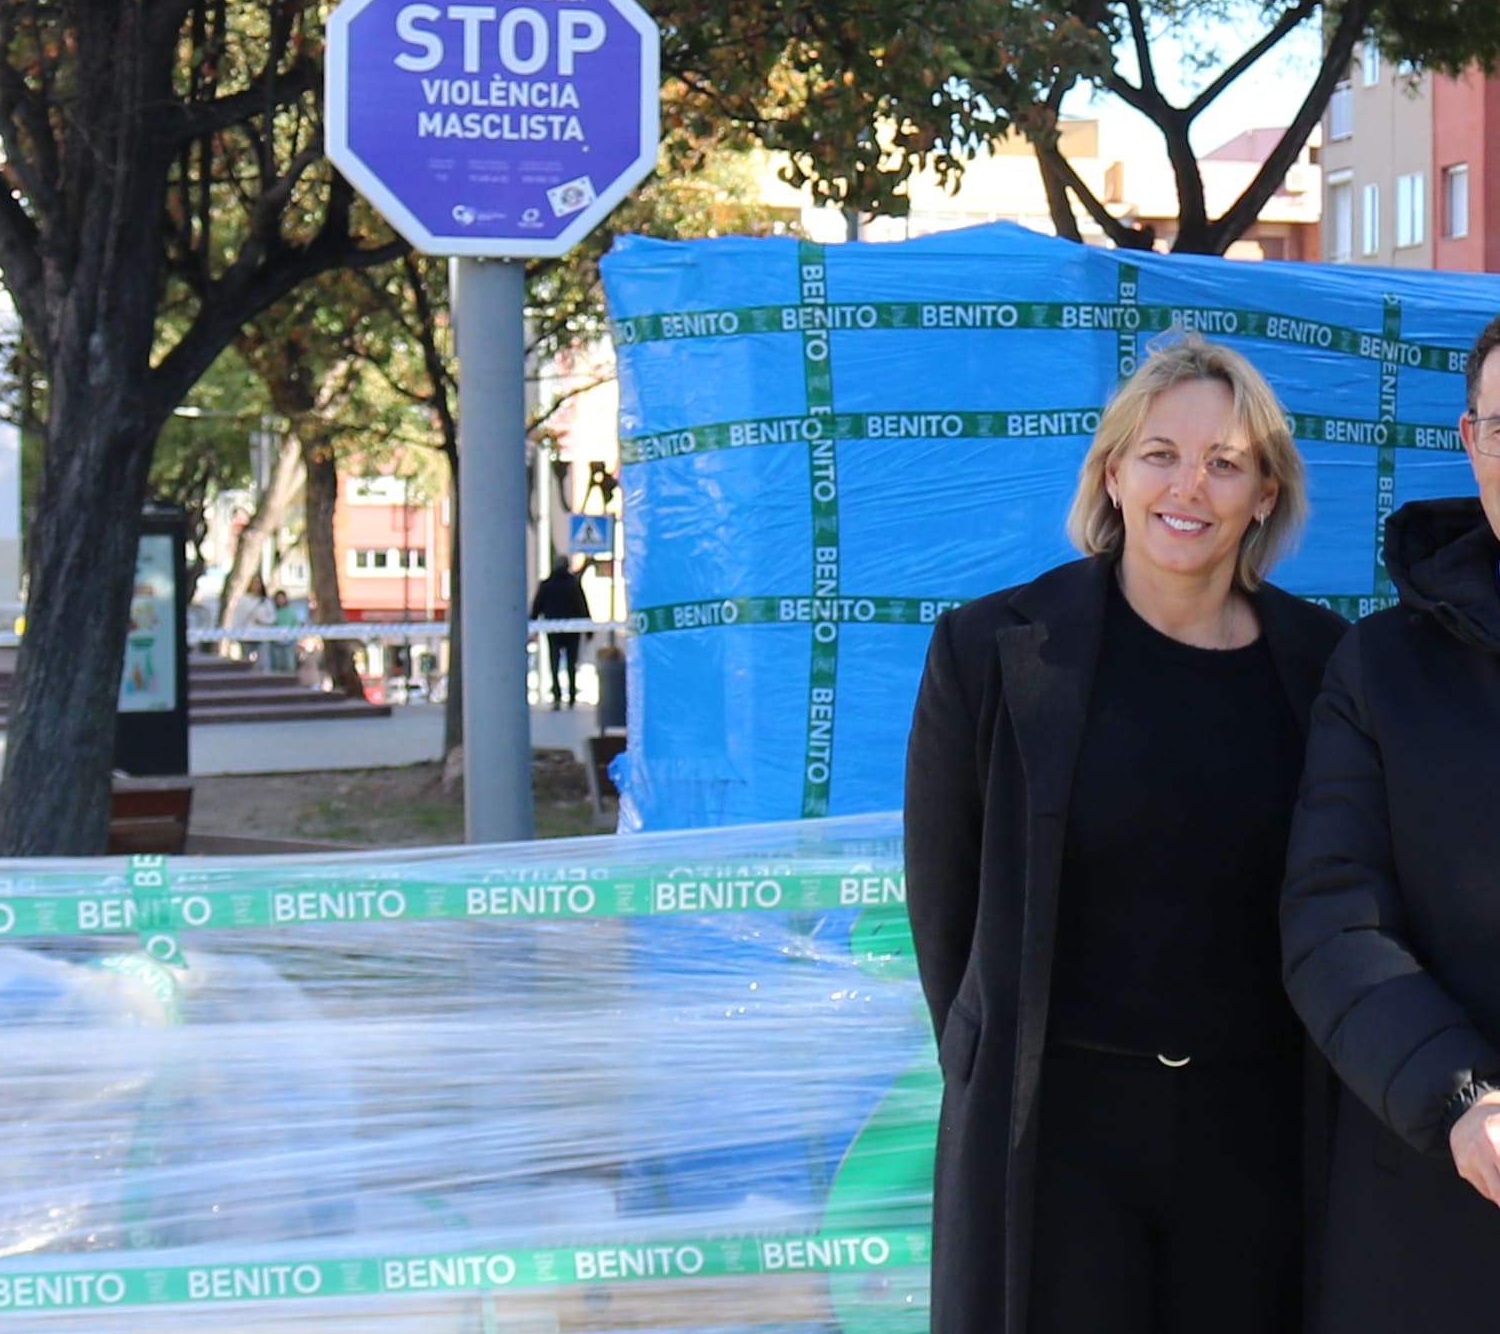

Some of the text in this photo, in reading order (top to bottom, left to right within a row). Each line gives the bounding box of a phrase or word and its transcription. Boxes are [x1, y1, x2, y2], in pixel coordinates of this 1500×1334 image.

[394, 3, 606, 76] STOP
[421, 73, 580, 108] VIOLÈNCIA
[418, 112, 584, 141] MASCLISTA
[661, 312, 738, 337] BENITO
[922, 304, 1018, 328] BENITO
[1266, 316, 1333, 347] BENITO
[729, 411, 1100, 447] BENITO BENITO BENITO
[1325, 420, 1388, 445] BENITO
[674, 599, 739, 628] BENITO
[808, 687, 834, 785] BENITO
[274, 889, 406, 923] BENITO
[466, 882, 597, 916] BENITO
[656, 879, 782, 912] BENITO
[187, 1265, 323, 1301] BENITO
[383, 1254, 516, 1290] BENITO
[575, 1245, 705, 1280] BENITO
[763, 1235, 890, 1270] BENITO
